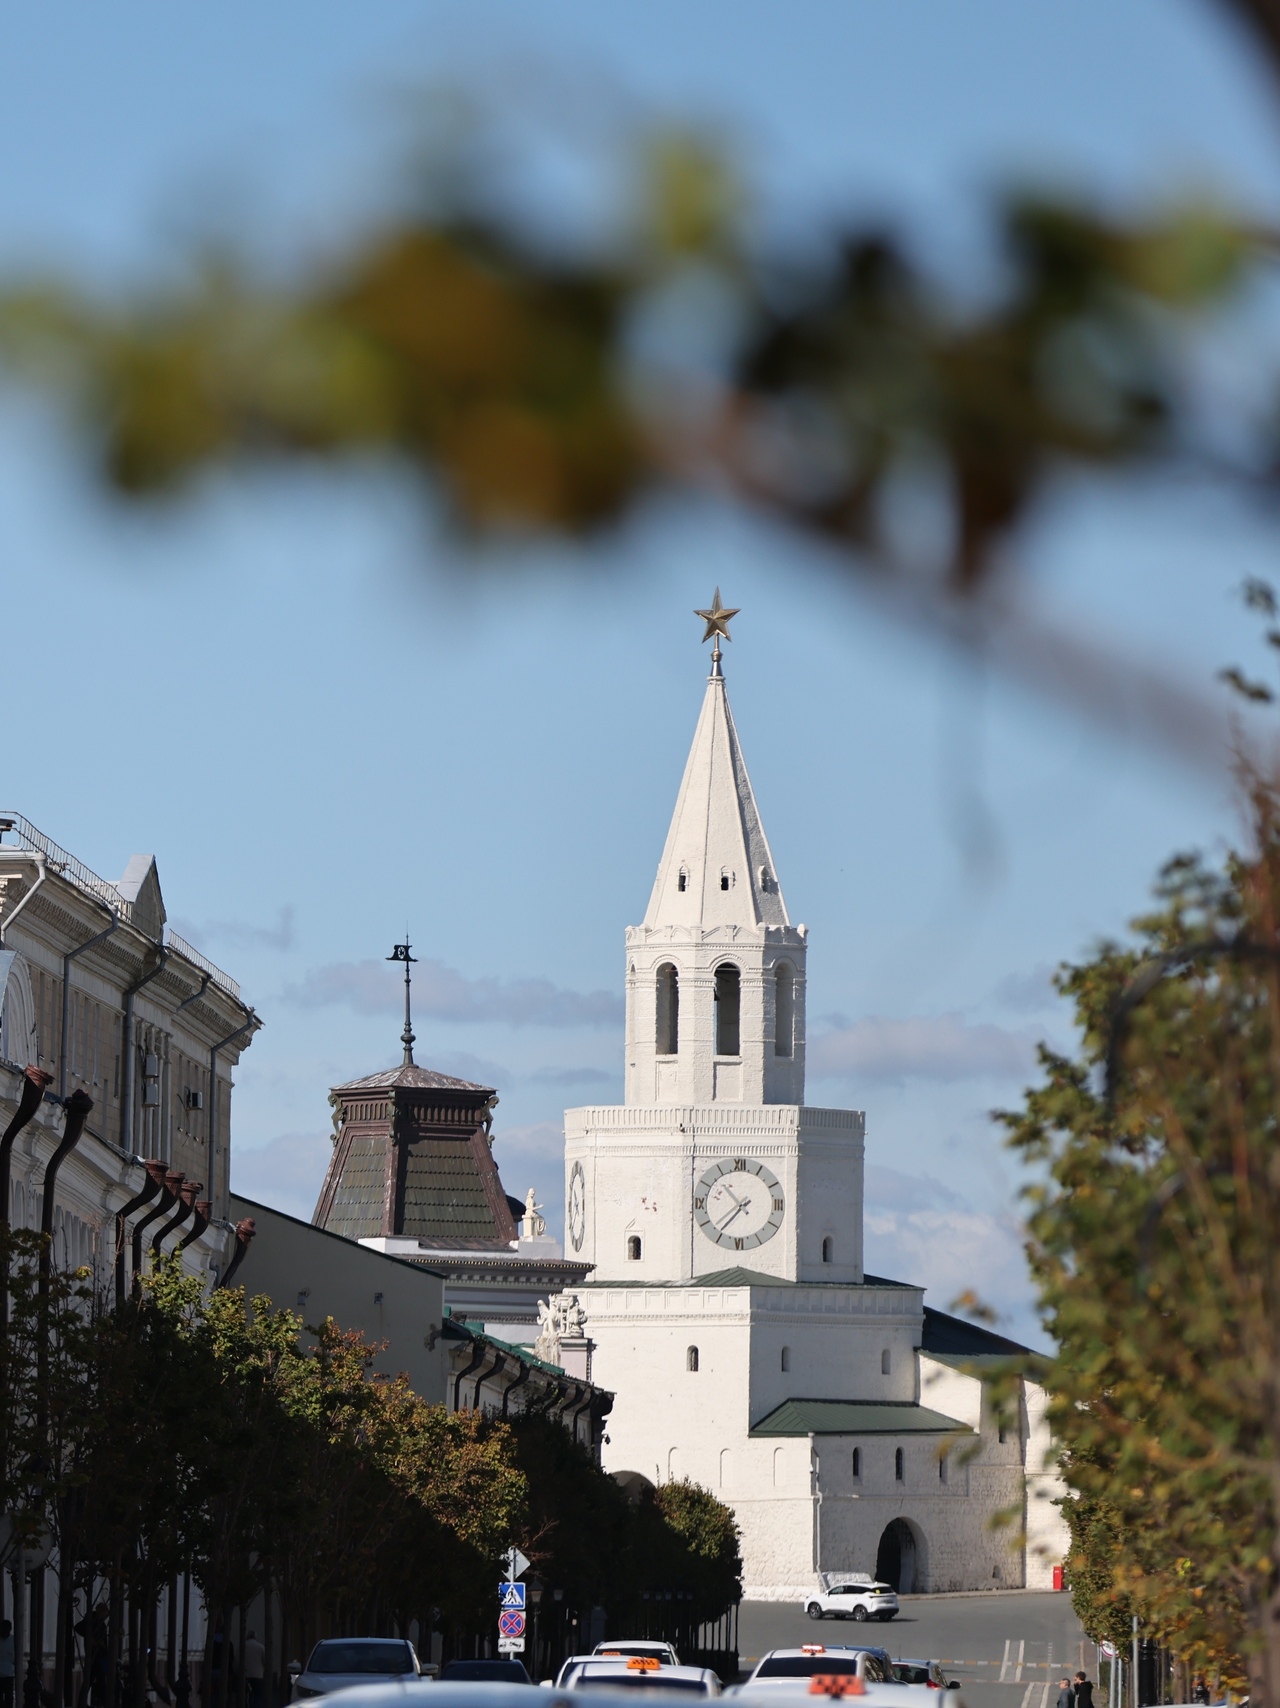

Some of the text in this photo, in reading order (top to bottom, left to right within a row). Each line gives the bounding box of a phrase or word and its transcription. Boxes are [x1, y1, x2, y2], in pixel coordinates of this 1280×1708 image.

[734, 1159, 746, 1171] XII
[695, 1198, 705, 1210] IX
[774, 1199, 783, 1211] III
[734, 1238, 744, 1250] VI
